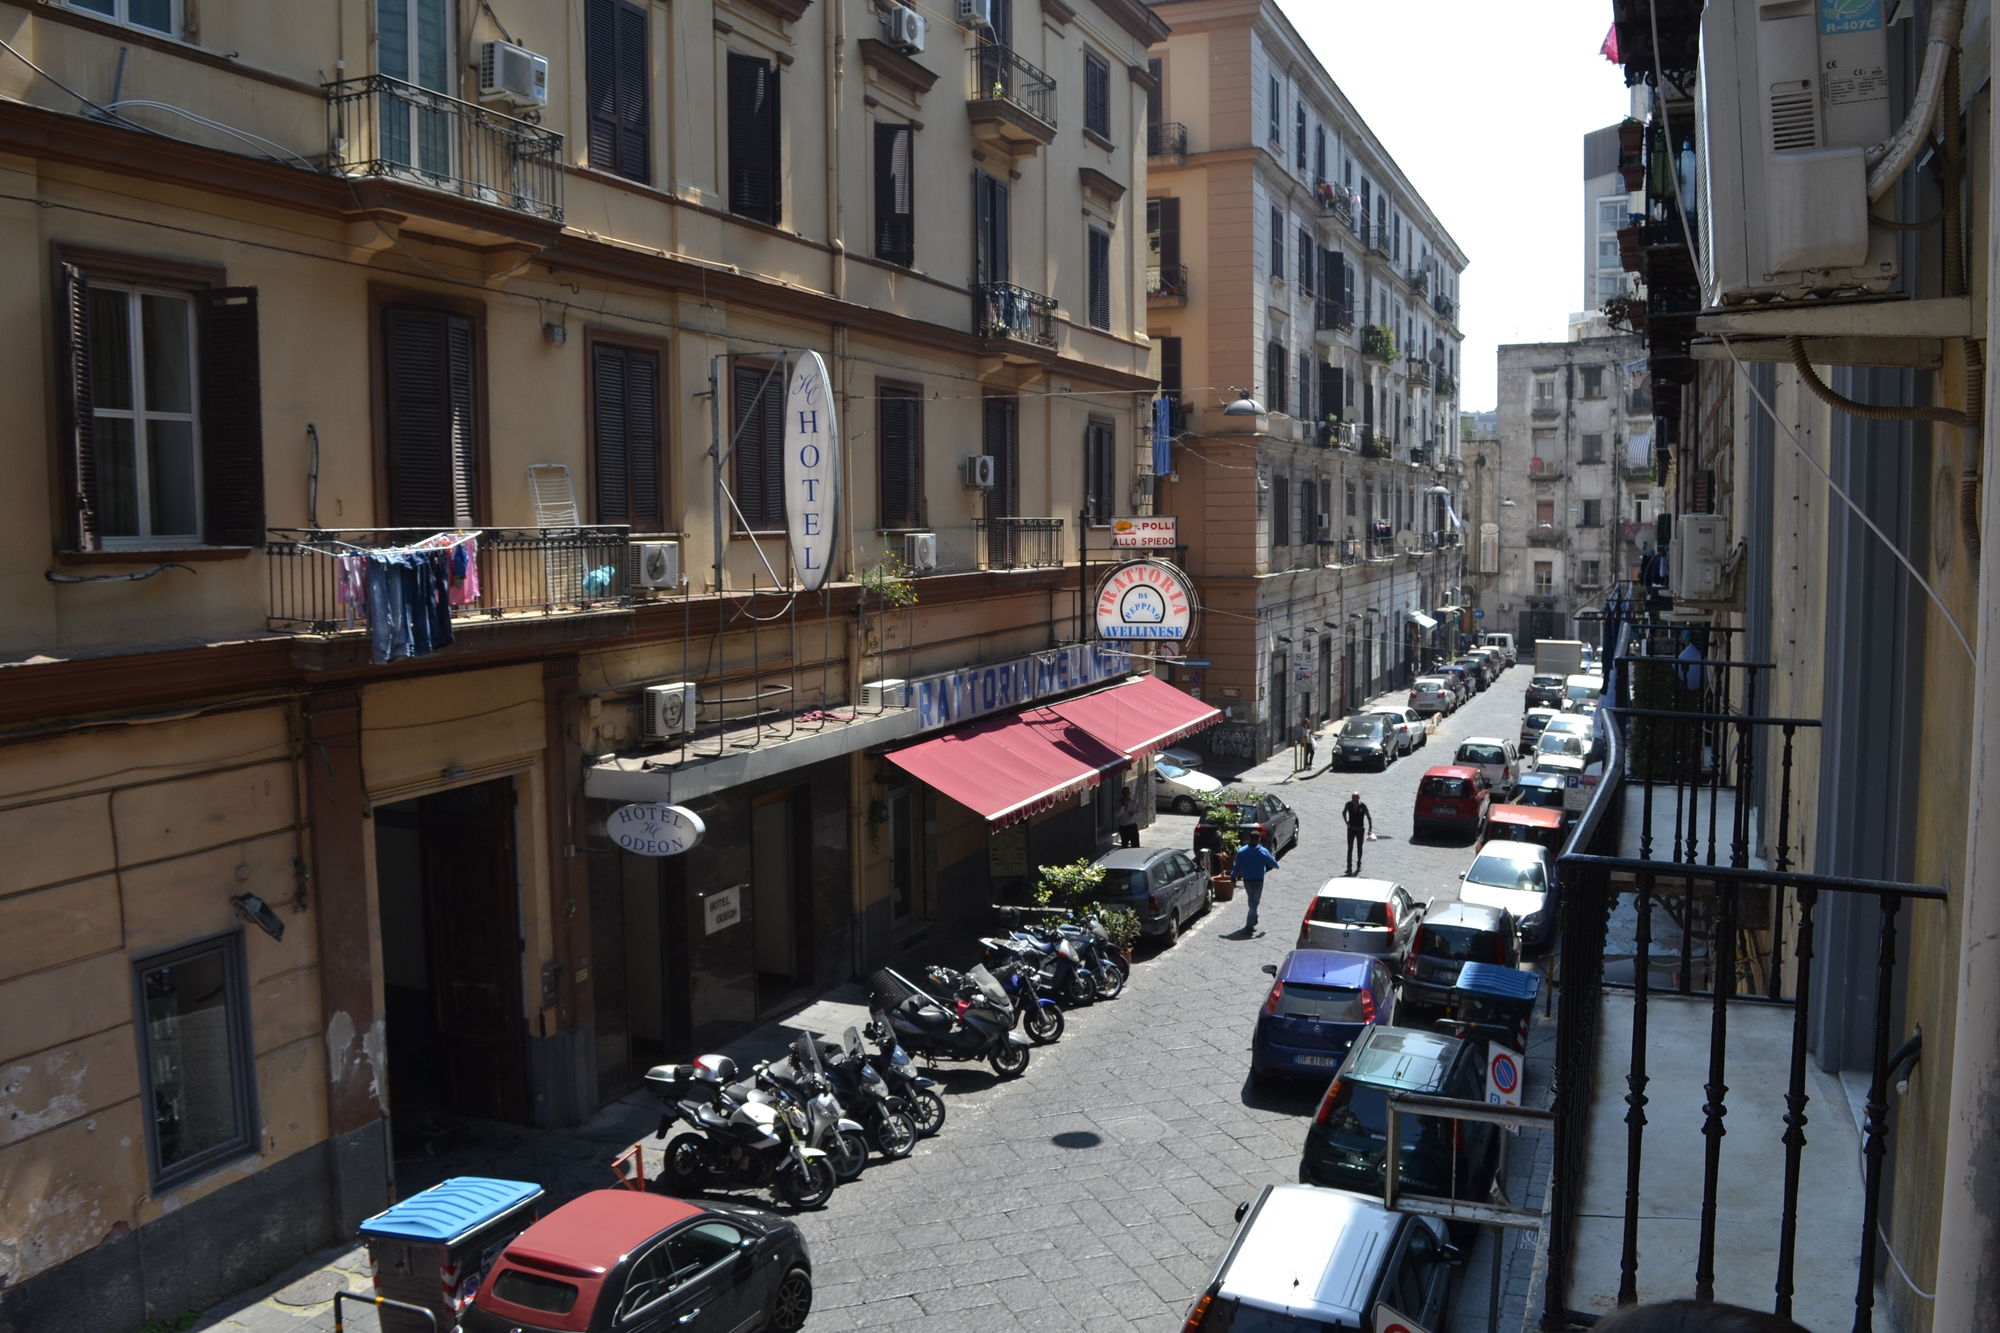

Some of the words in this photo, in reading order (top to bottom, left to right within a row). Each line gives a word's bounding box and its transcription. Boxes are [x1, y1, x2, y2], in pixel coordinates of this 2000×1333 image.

[1826, 19, 1875, 33] R-407C
[798, 410, 821, 570] HOTEL
[1142, 522, 1175, 531] POLLI
[1112, 538, 1137, 546] ALLO
[1141, 537, 1175, 546] SPIEDO
[1098, 566, 1188, 617] TRATTORIA
[1138, 592, 1148, 600] DA
[1125, 602, 1161, 620] PEPPINO
[1103, 626, 1183, 638] AVELLINESE
[618, 806, 683, 829] HOTEL
[619, 834, 684, 854] ODEON
[709, 896, 730, 912] HOTEL
[715, 907, 737, 924] ODEON
